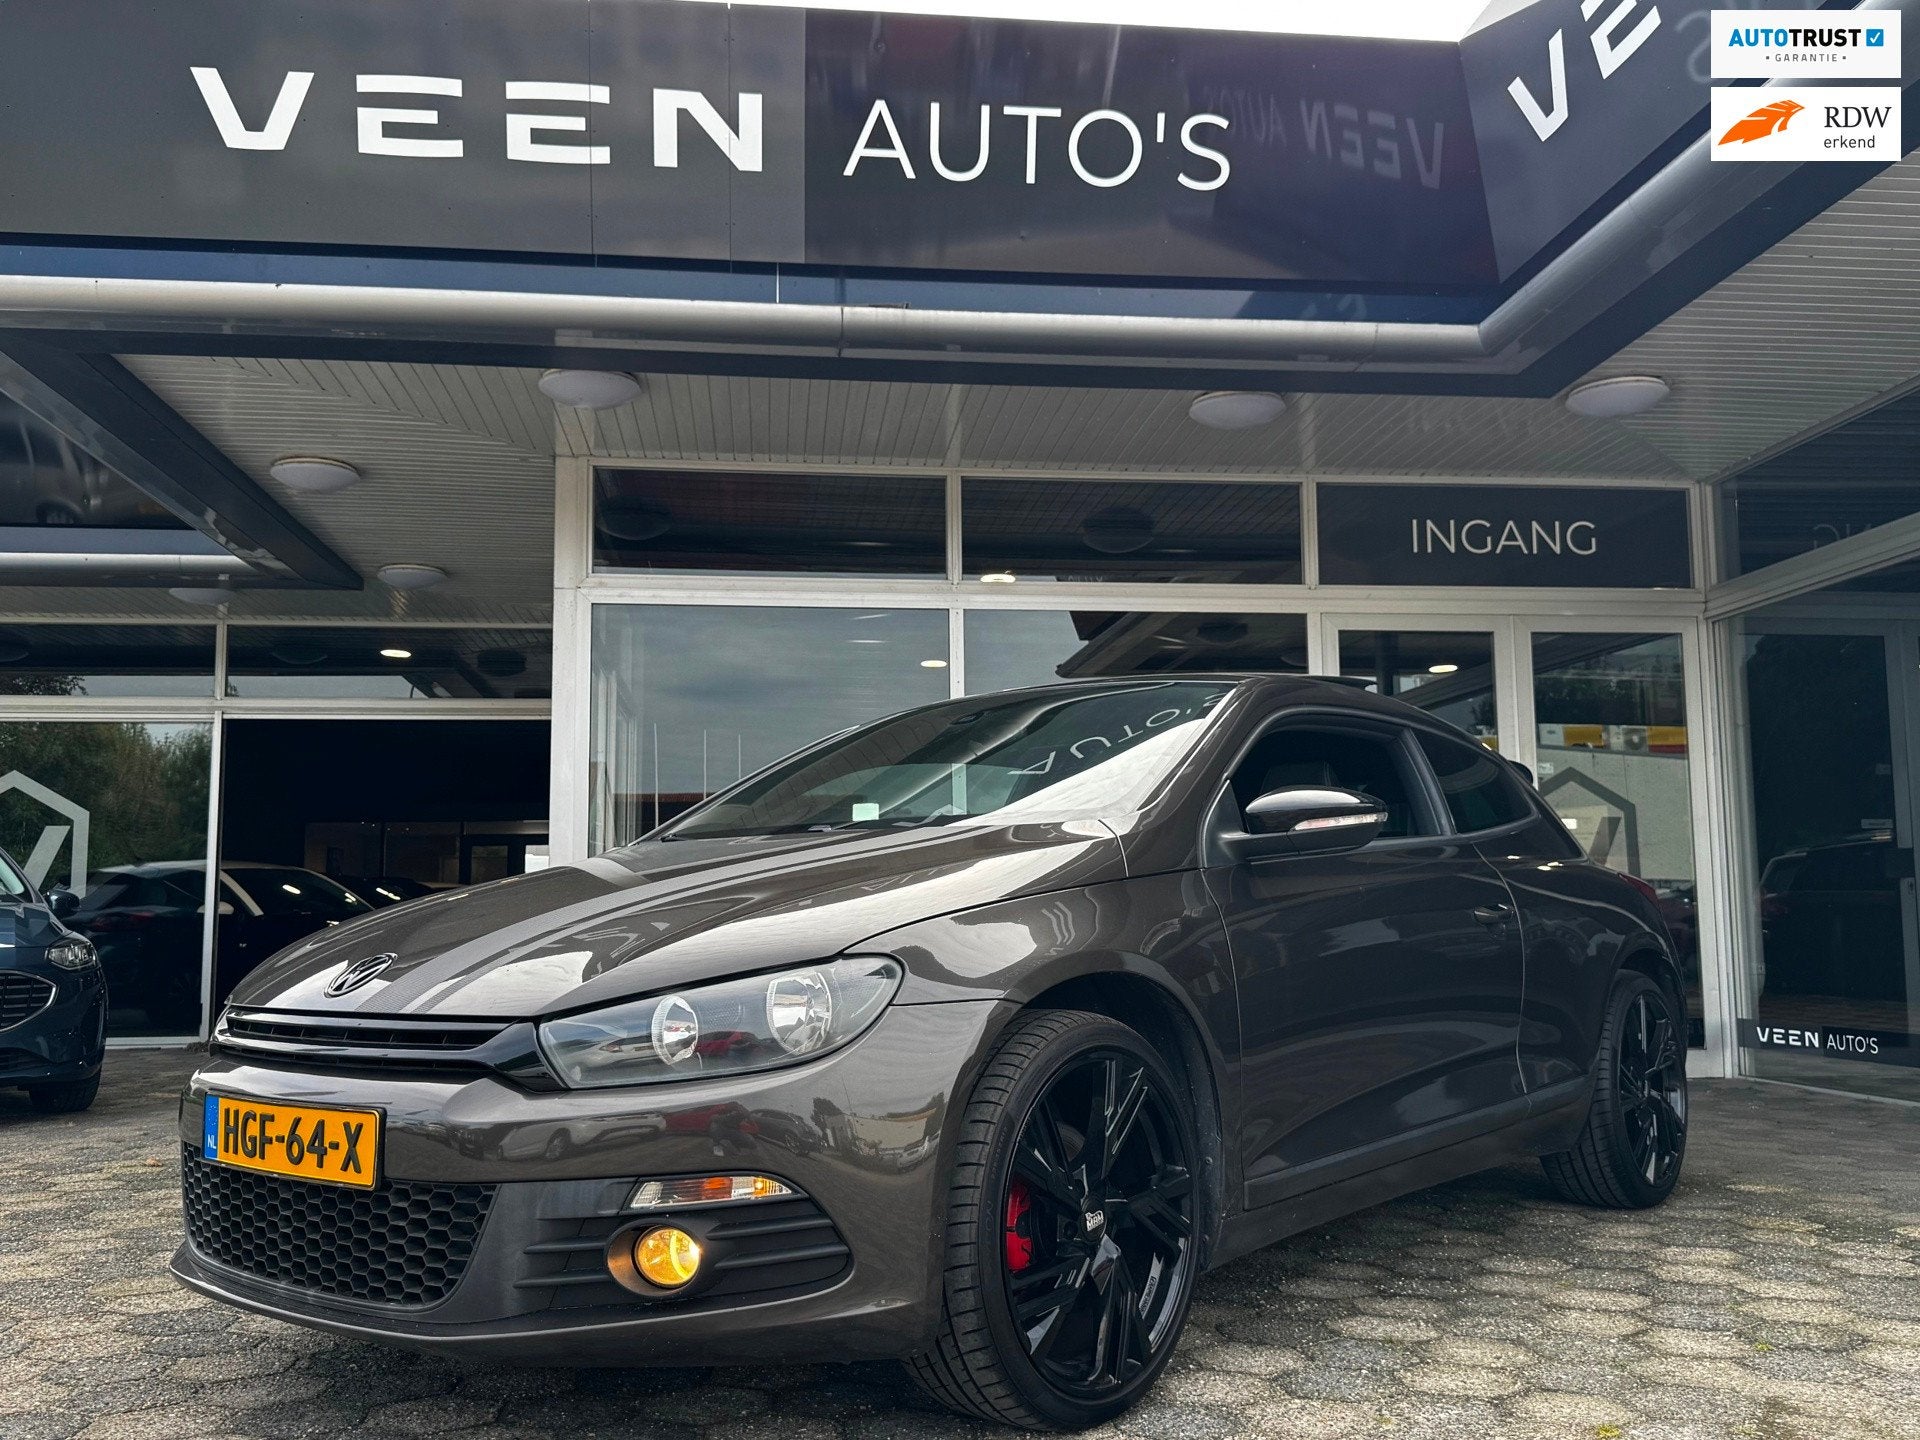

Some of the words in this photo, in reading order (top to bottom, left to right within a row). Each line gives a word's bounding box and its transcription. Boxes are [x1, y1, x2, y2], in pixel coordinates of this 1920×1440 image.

[1507, 0, 1662, 142] VE
[190, 66, 763, 172] VEEN
[843, 99, 1231, 191] AUTO'S
[1411, 518, 1598, 556] INGANG
[1756, 1026, 1820, 1048] VEEN
[1826, 1033, 1880, 1055] AUTO'S
[206, 1134, 217, 1150] NL
[222, 1106, 365, 1175] HGF-64-X
